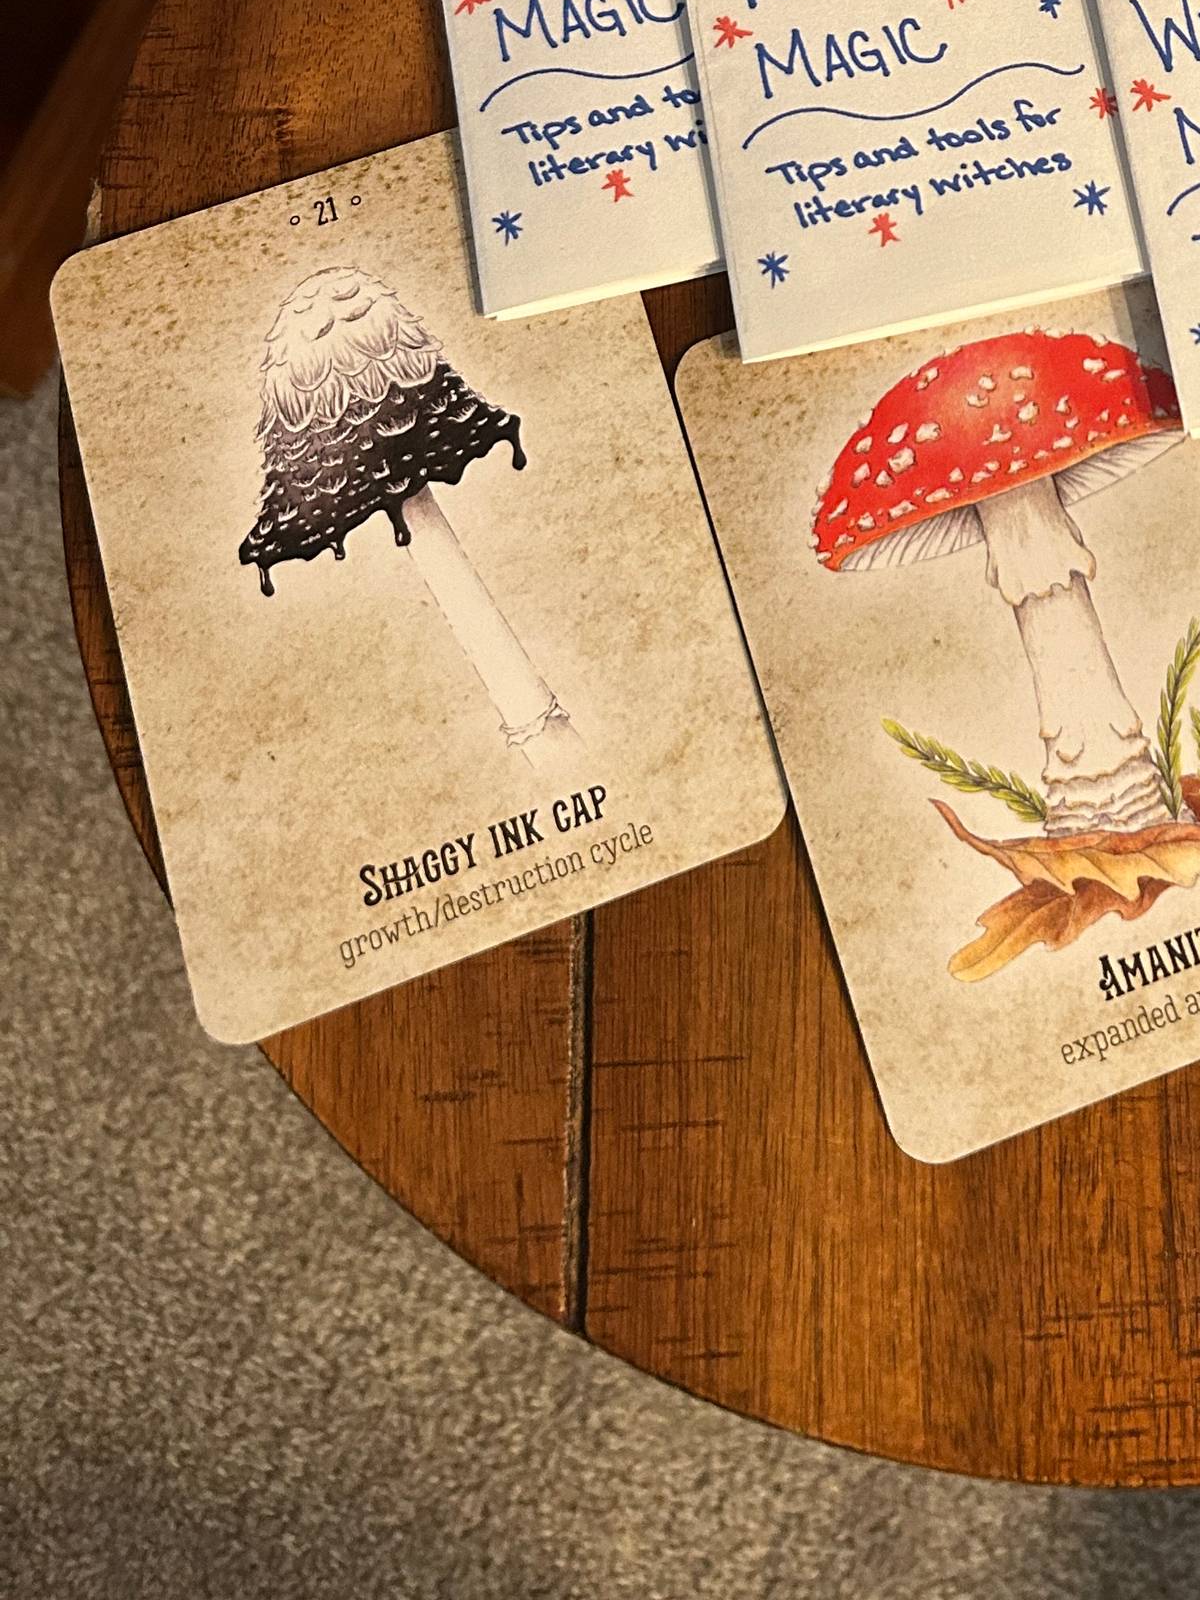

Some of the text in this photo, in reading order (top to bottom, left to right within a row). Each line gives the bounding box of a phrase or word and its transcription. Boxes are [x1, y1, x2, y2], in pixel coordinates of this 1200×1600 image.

[754, 18, 949, 99] MAGIC
[501, 116, 582, 151] Tips
[587, 94, 654, 128] and
[764, 98, 1062, 193] Tips and tools for
[527, 141, 657, 186] literary
[794, 152, 1073, 228] literary witches
[359, 784, 608, 907] SHAGGY INK CAP
[338, 822, 655, 969] growth/destruction cycle
[1060, 994, 1182, 1065] expanded
